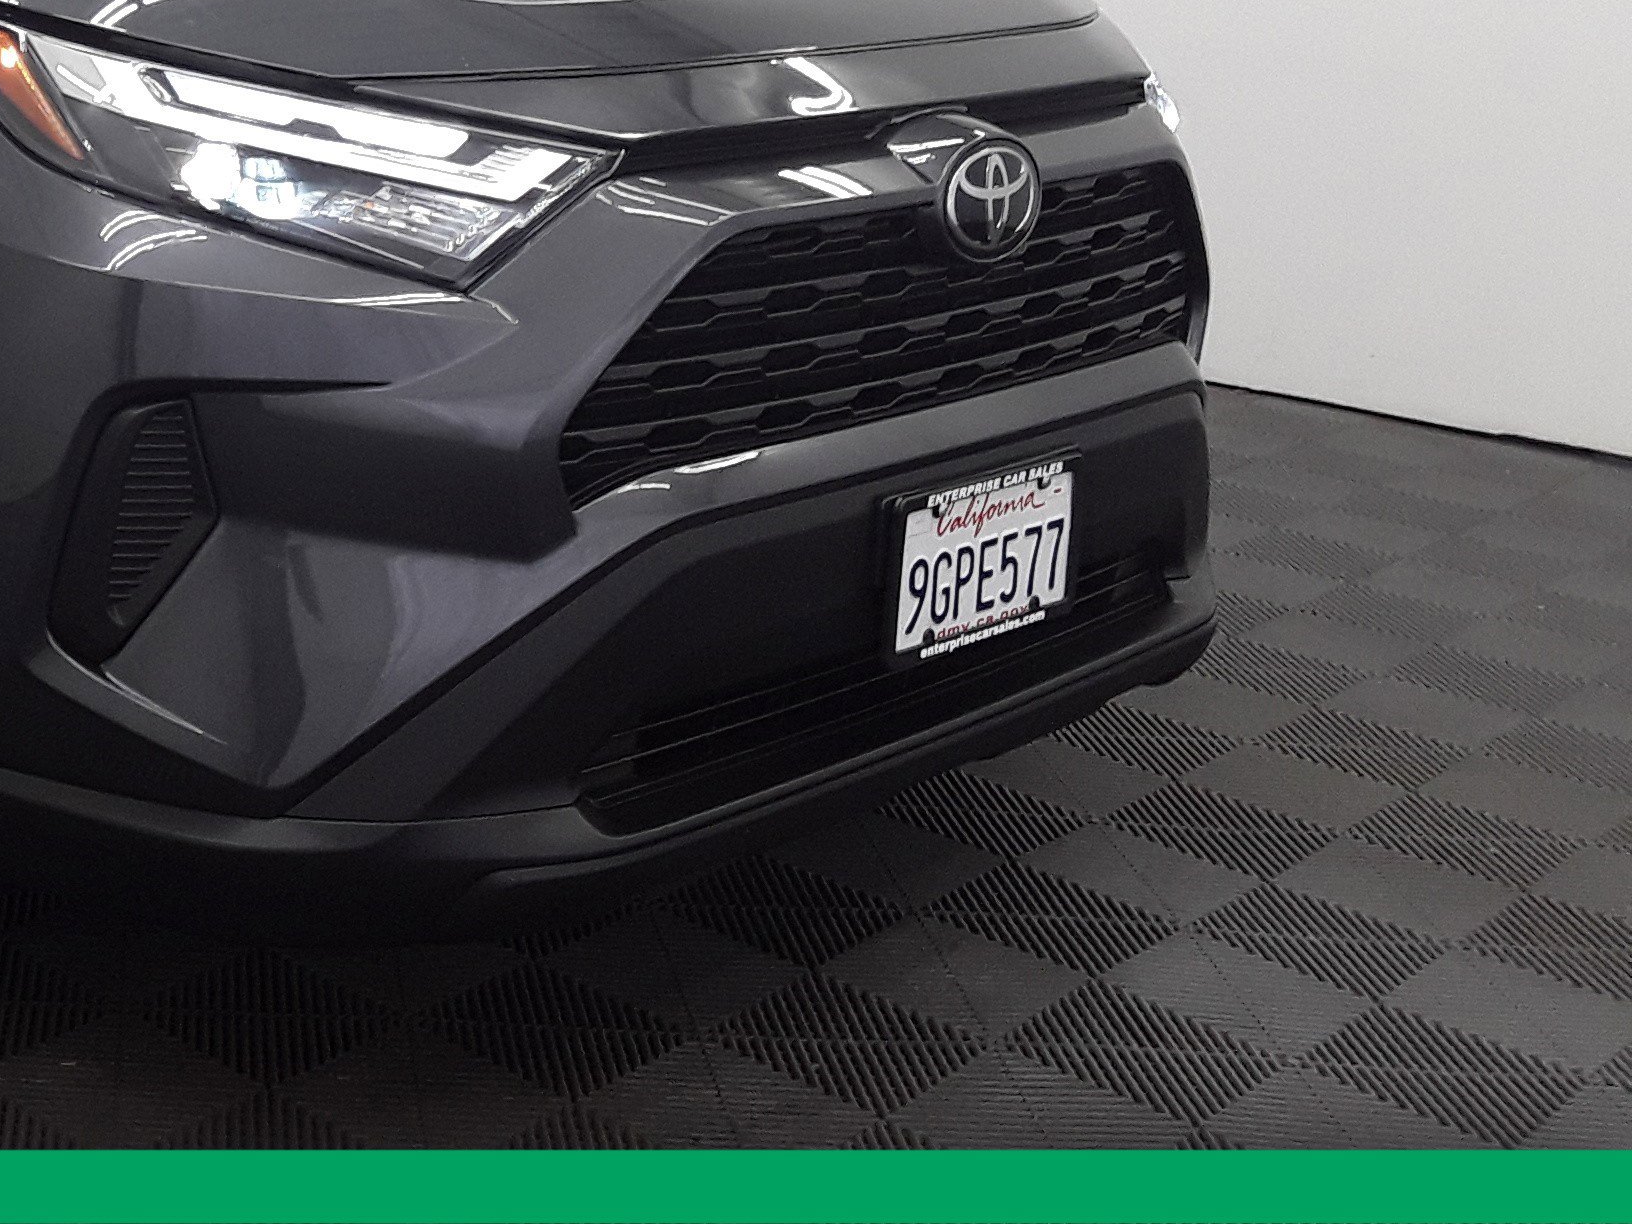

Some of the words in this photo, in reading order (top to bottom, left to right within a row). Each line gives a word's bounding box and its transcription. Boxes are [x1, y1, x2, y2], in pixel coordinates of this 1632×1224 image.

[928, 477, 1001, 507] ENTERPRISE
[1003, 470, 1026, 488] CAR
[1029, 461, 1063, 481] SALES
[936, 491, 1044, 536] California
[906, 518, 1064, 635] 9GPE577
[921, 610, 1045, 658] enterprisecarsales.com
